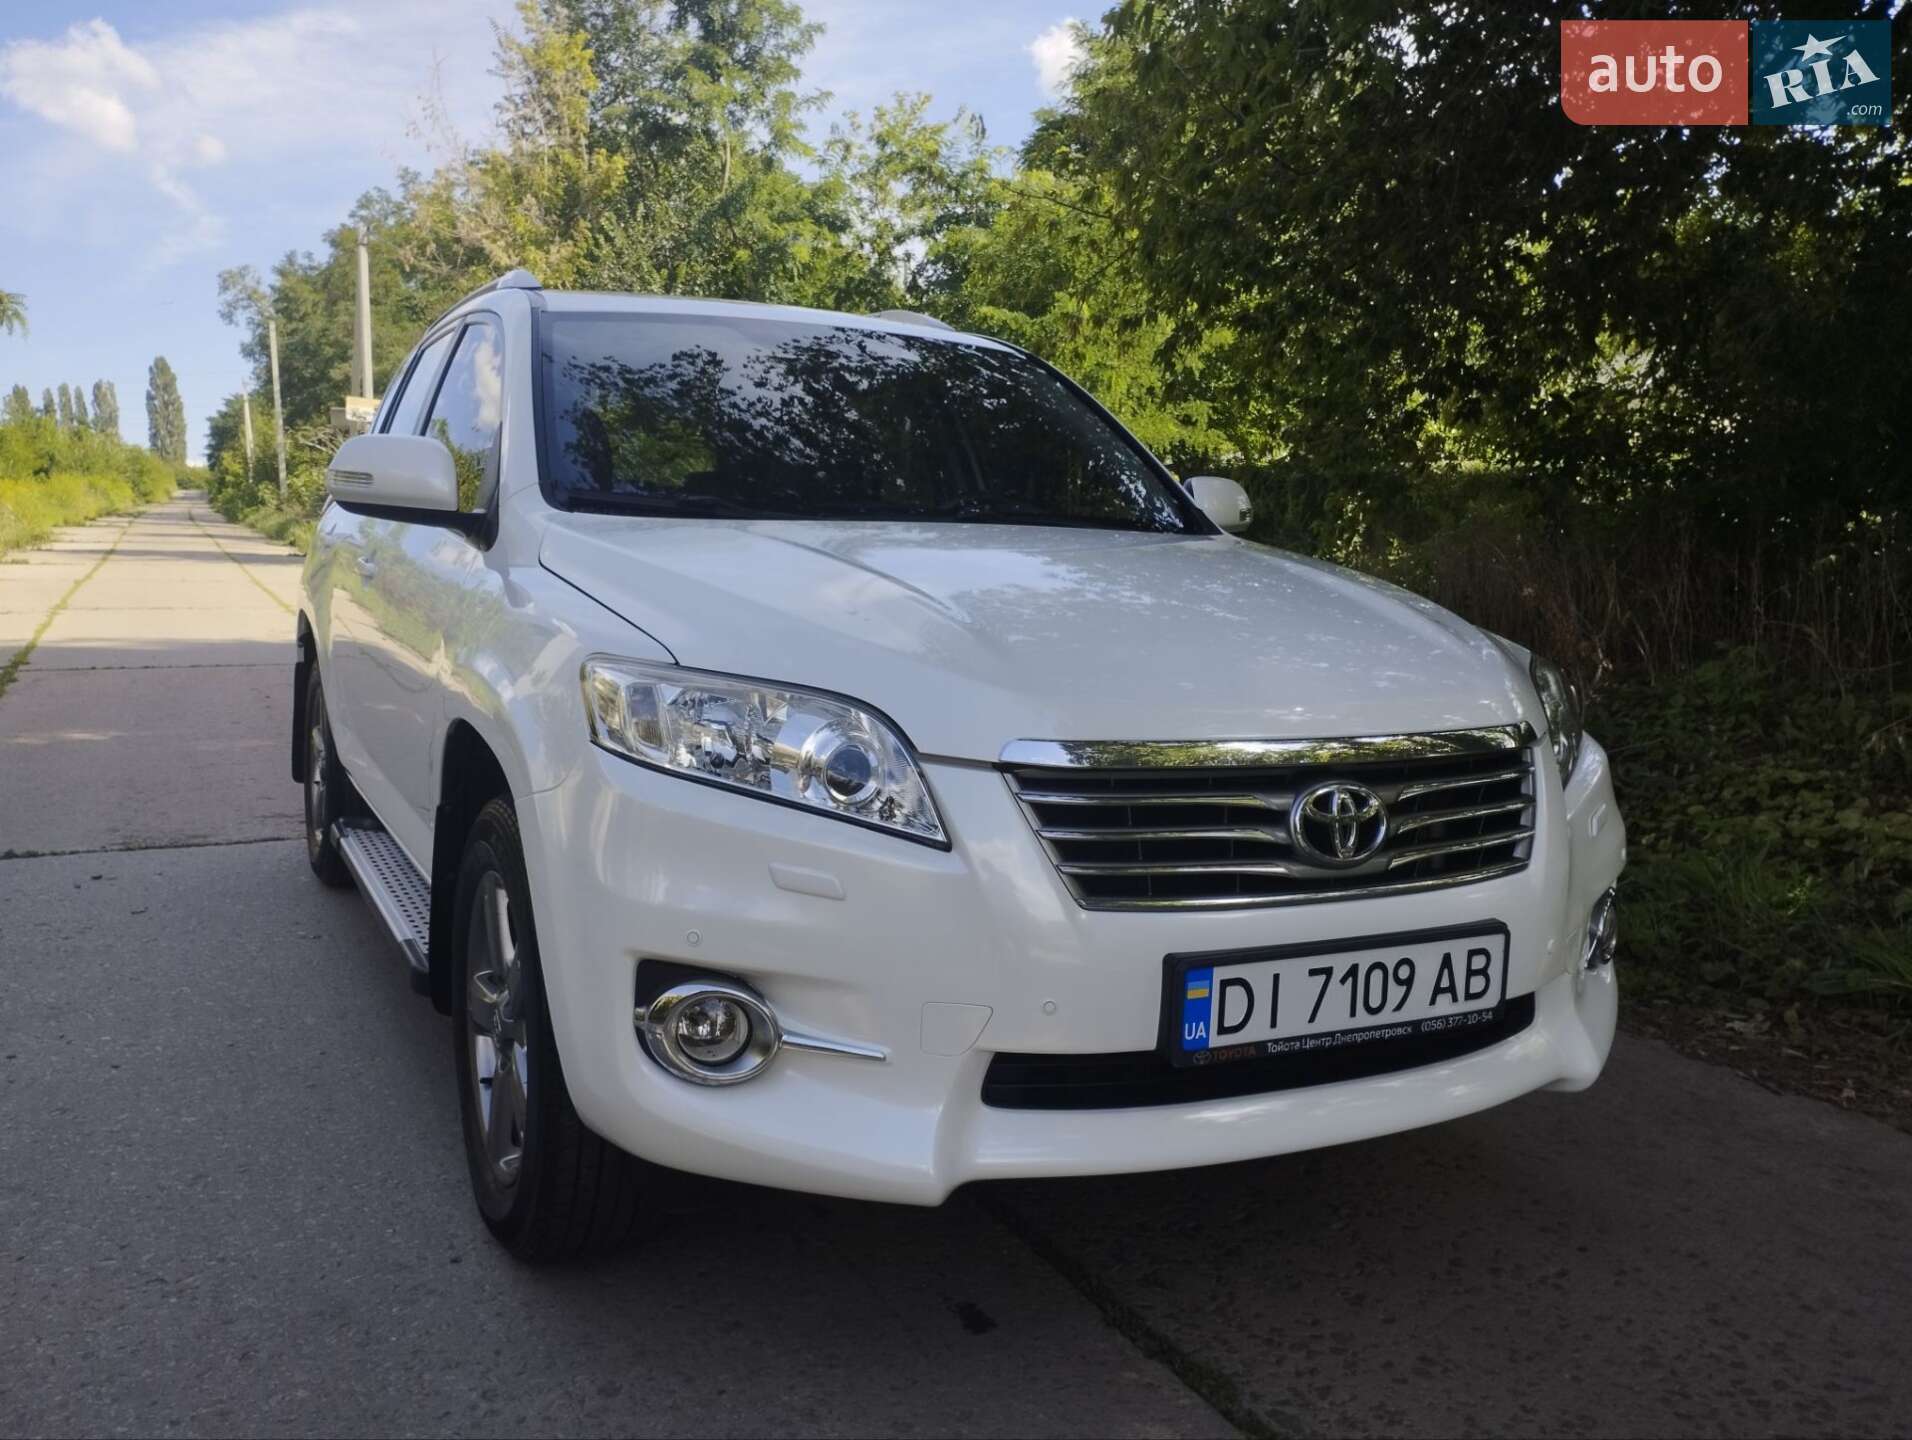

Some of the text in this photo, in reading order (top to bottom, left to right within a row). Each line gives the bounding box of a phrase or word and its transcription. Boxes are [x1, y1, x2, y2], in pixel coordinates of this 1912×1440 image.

[1216, 947, 1492, 1036] DI 7109 AB
[1184, 1021, 1207, 1041] UA
[1267, 1025, 1413, 1053] Тойота Центр Днепропетровск
